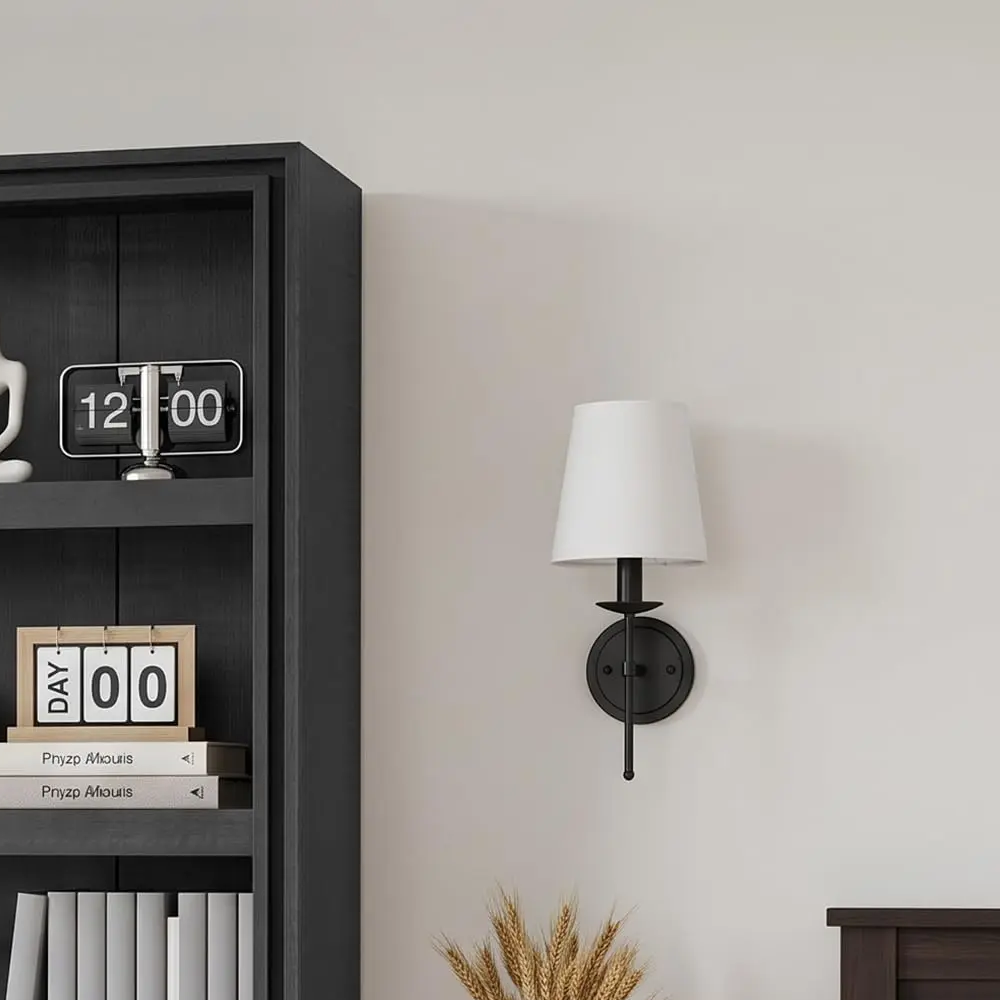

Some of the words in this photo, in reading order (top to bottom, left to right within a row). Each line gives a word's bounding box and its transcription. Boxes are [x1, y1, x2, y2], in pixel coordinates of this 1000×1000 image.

[80, 391, 128, 429] 12
[171, 388, 223, 427] 00
[47, 661, 69, 714] DAY
